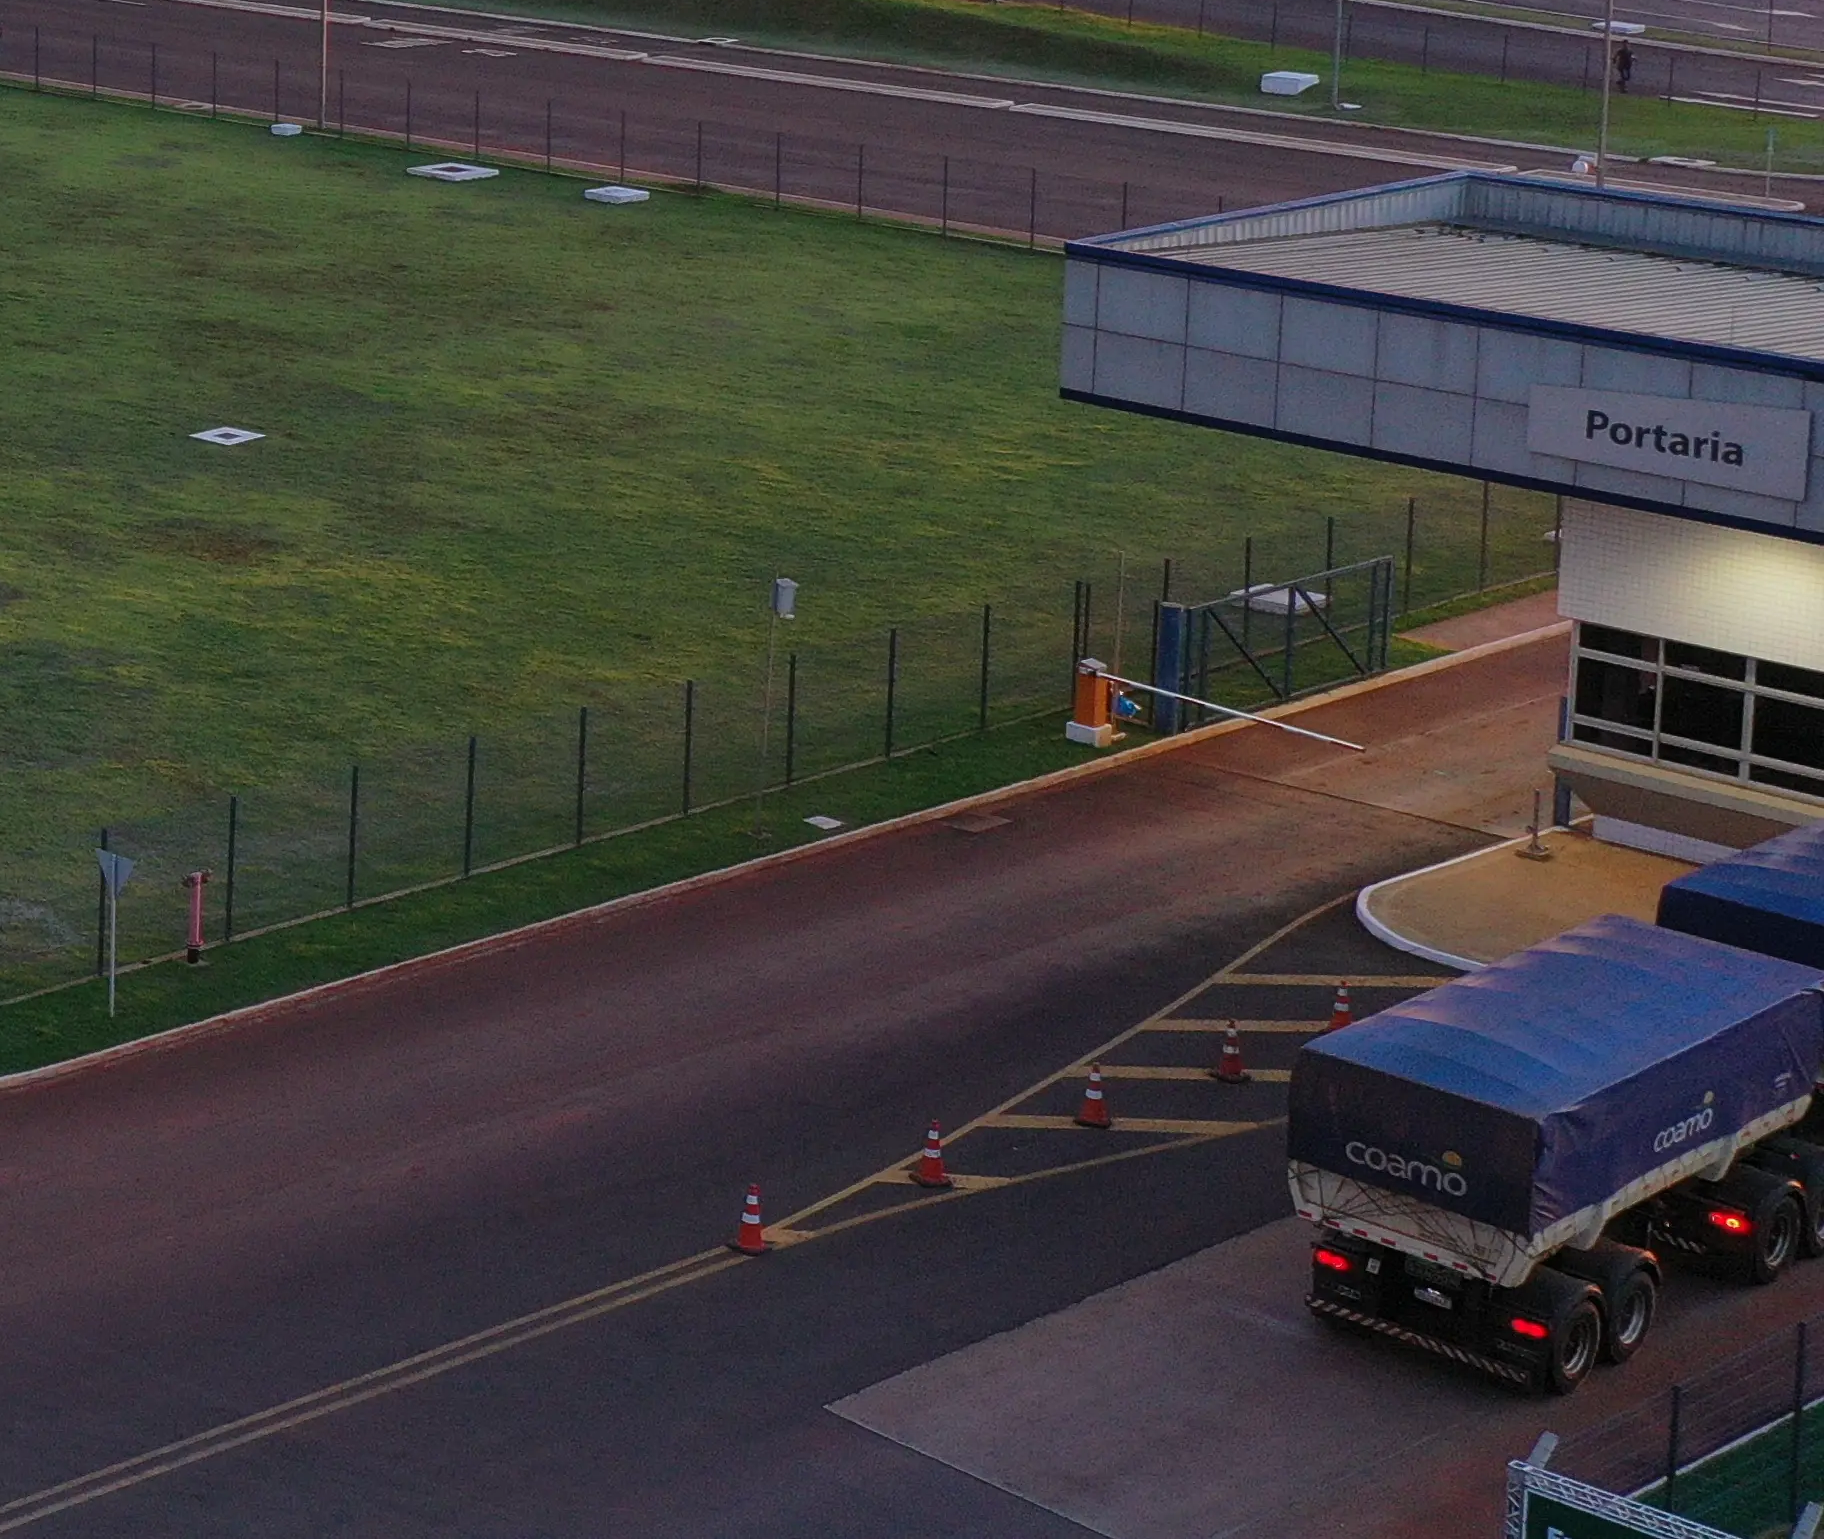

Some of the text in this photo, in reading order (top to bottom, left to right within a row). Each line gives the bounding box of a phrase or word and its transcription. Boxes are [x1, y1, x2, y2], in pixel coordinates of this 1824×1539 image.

[1585, 409, 1744, 467] Portaria
[1654, 1108, 1714, 1153] coamo
[1345, 1140, 1468, 1197] coamo
